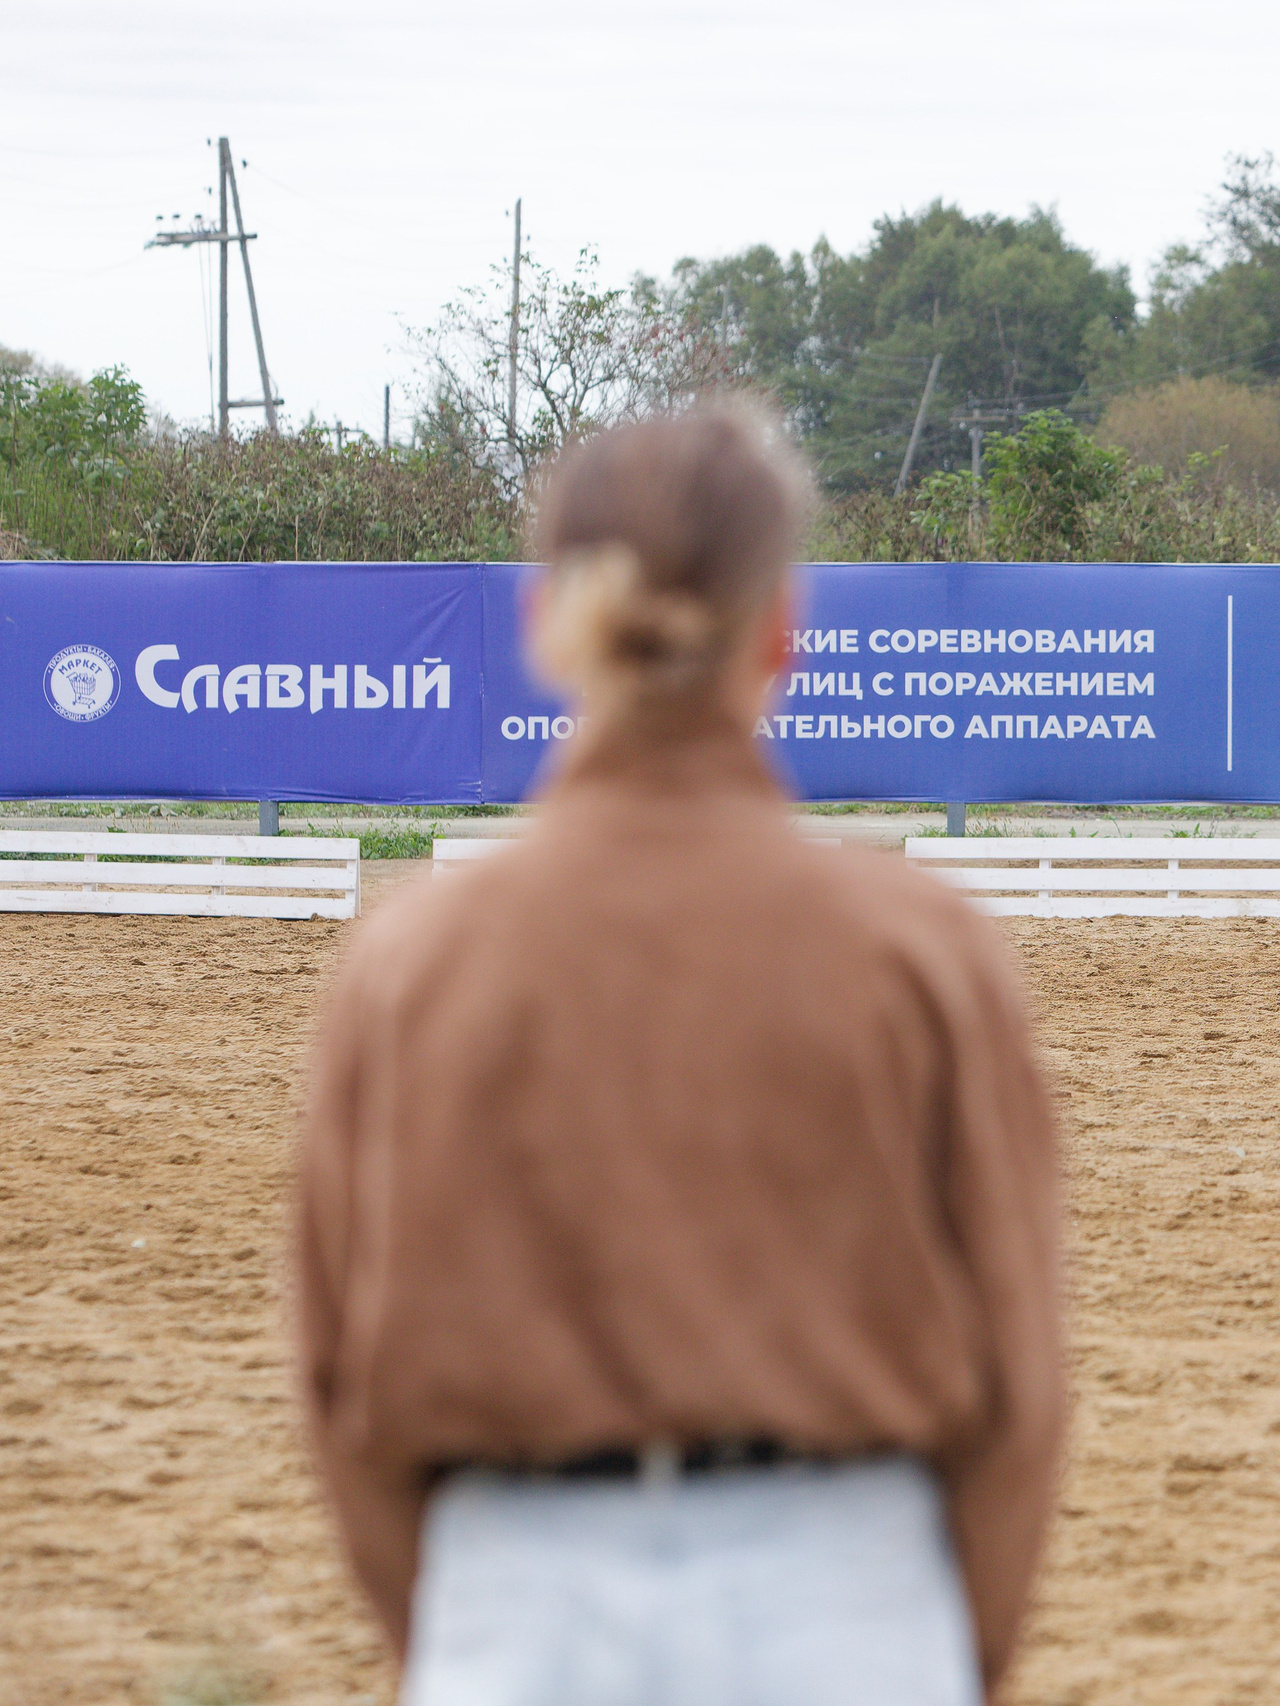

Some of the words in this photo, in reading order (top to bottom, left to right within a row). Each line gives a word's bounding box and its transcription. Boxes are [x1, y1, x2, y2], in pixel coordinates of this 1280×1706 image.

[868, 629, 1155, 653] СОРЕВНОВАНИЯ
[58, 658, 102, 675] МАРКЕТ
[786, 672, 863, 700] ЛИЦ
[872, 671, 894, 696] С
[904, 671, 1154, 696] ПОРАЖЕНИЕМ
[752, 714, 955, 739] АТЕЛЬНОГО
[964, 715, 1156, 739] АППАРАТА
